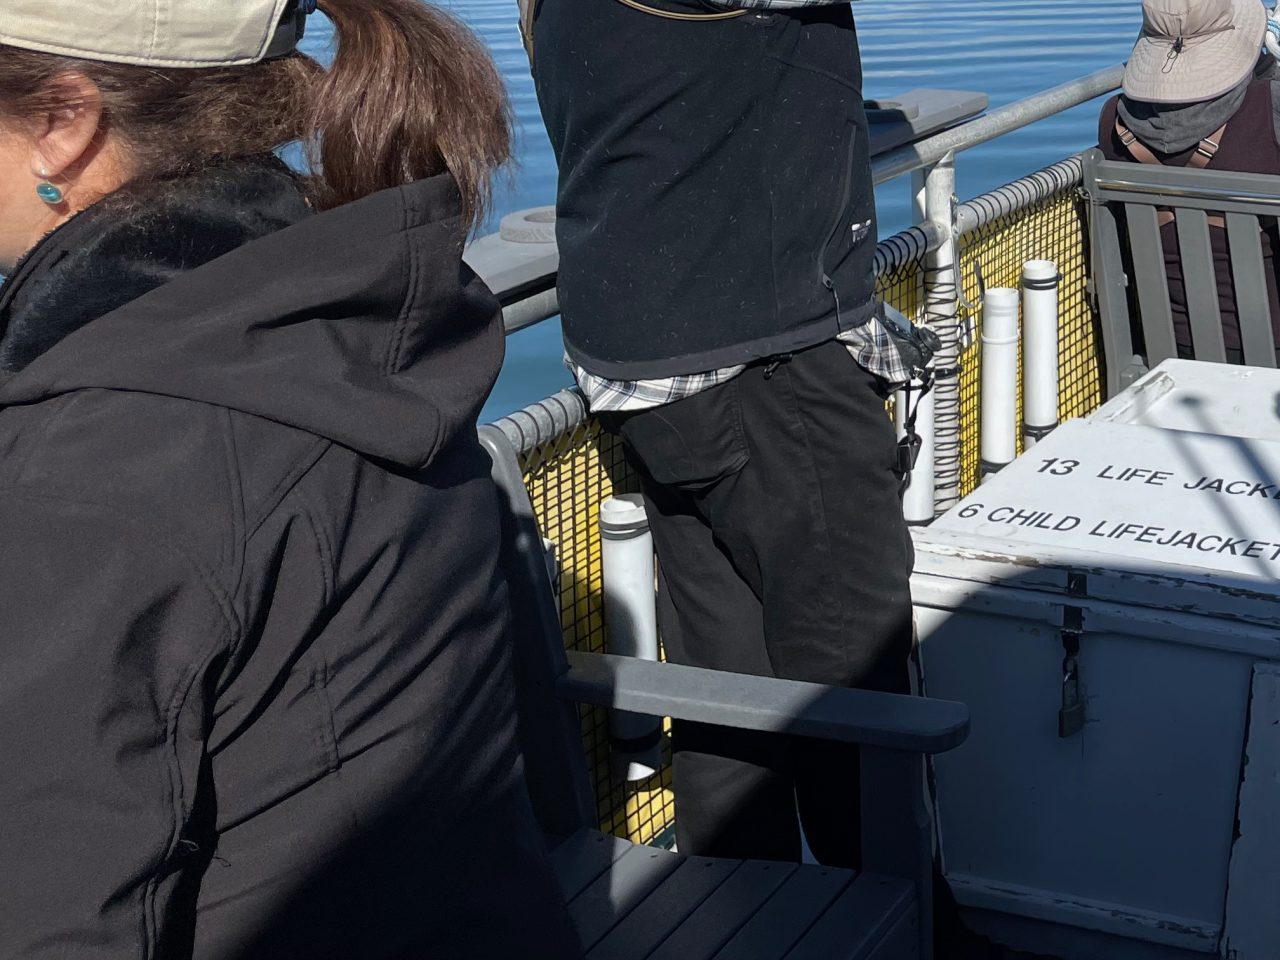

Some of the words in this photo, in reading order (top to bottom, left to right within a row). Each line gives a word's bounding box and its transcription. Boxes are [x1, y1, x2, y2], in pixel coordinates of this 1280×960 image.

[1037, 457, 1080, 476] 13
[1096, 465, 1174, 486] LIFE
[957, 503, 984, 519] 6
[987, 507, 1081, 532] CHILD
